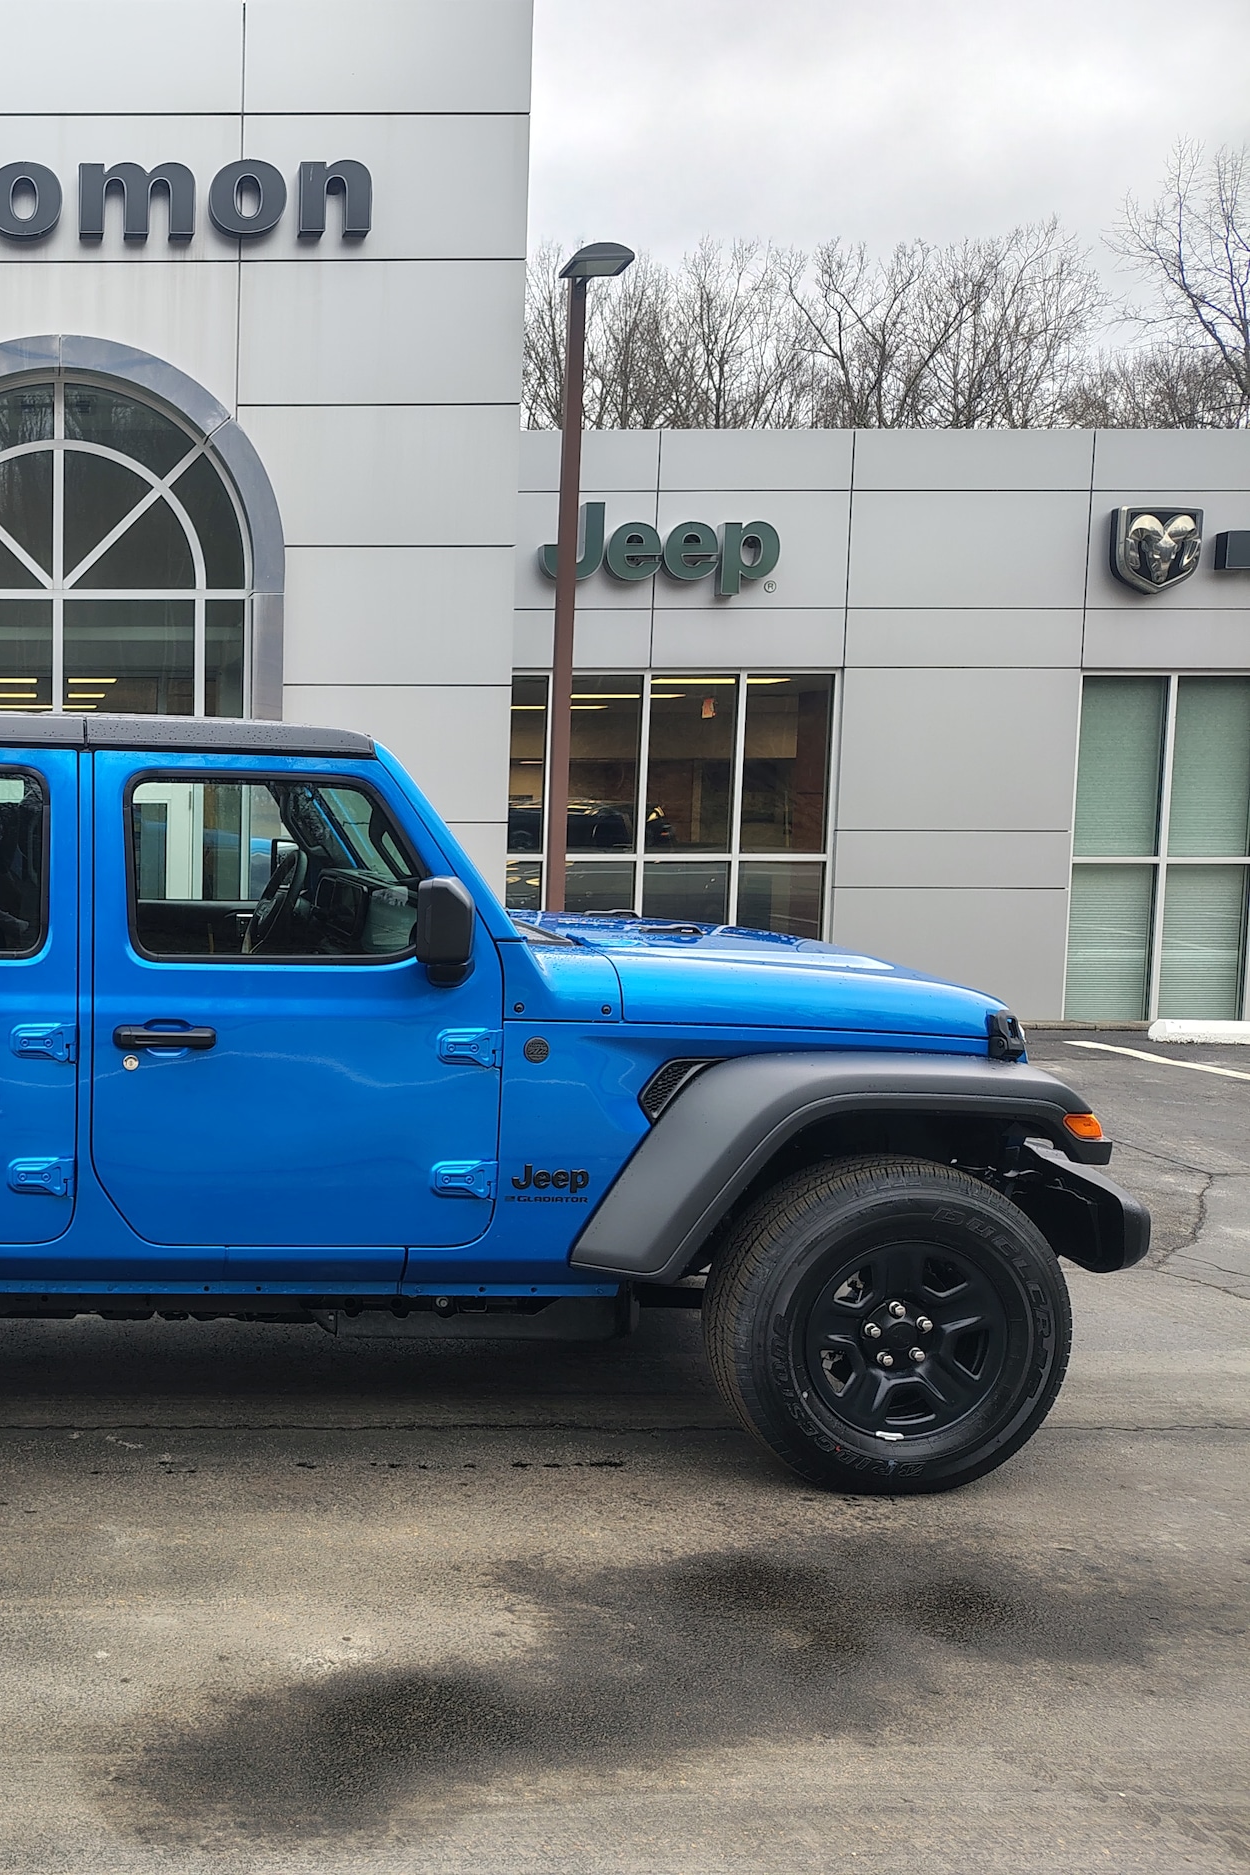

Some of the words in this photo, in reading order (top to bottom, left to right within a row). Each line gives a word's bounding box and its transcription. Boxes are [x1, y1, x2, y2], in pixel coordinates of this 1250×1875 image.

[537, 502, 781, 597] Jeep
[511, 1163, 589, 1194] Jeep
[517, 1195, 588, 1203] GLADIATOR
